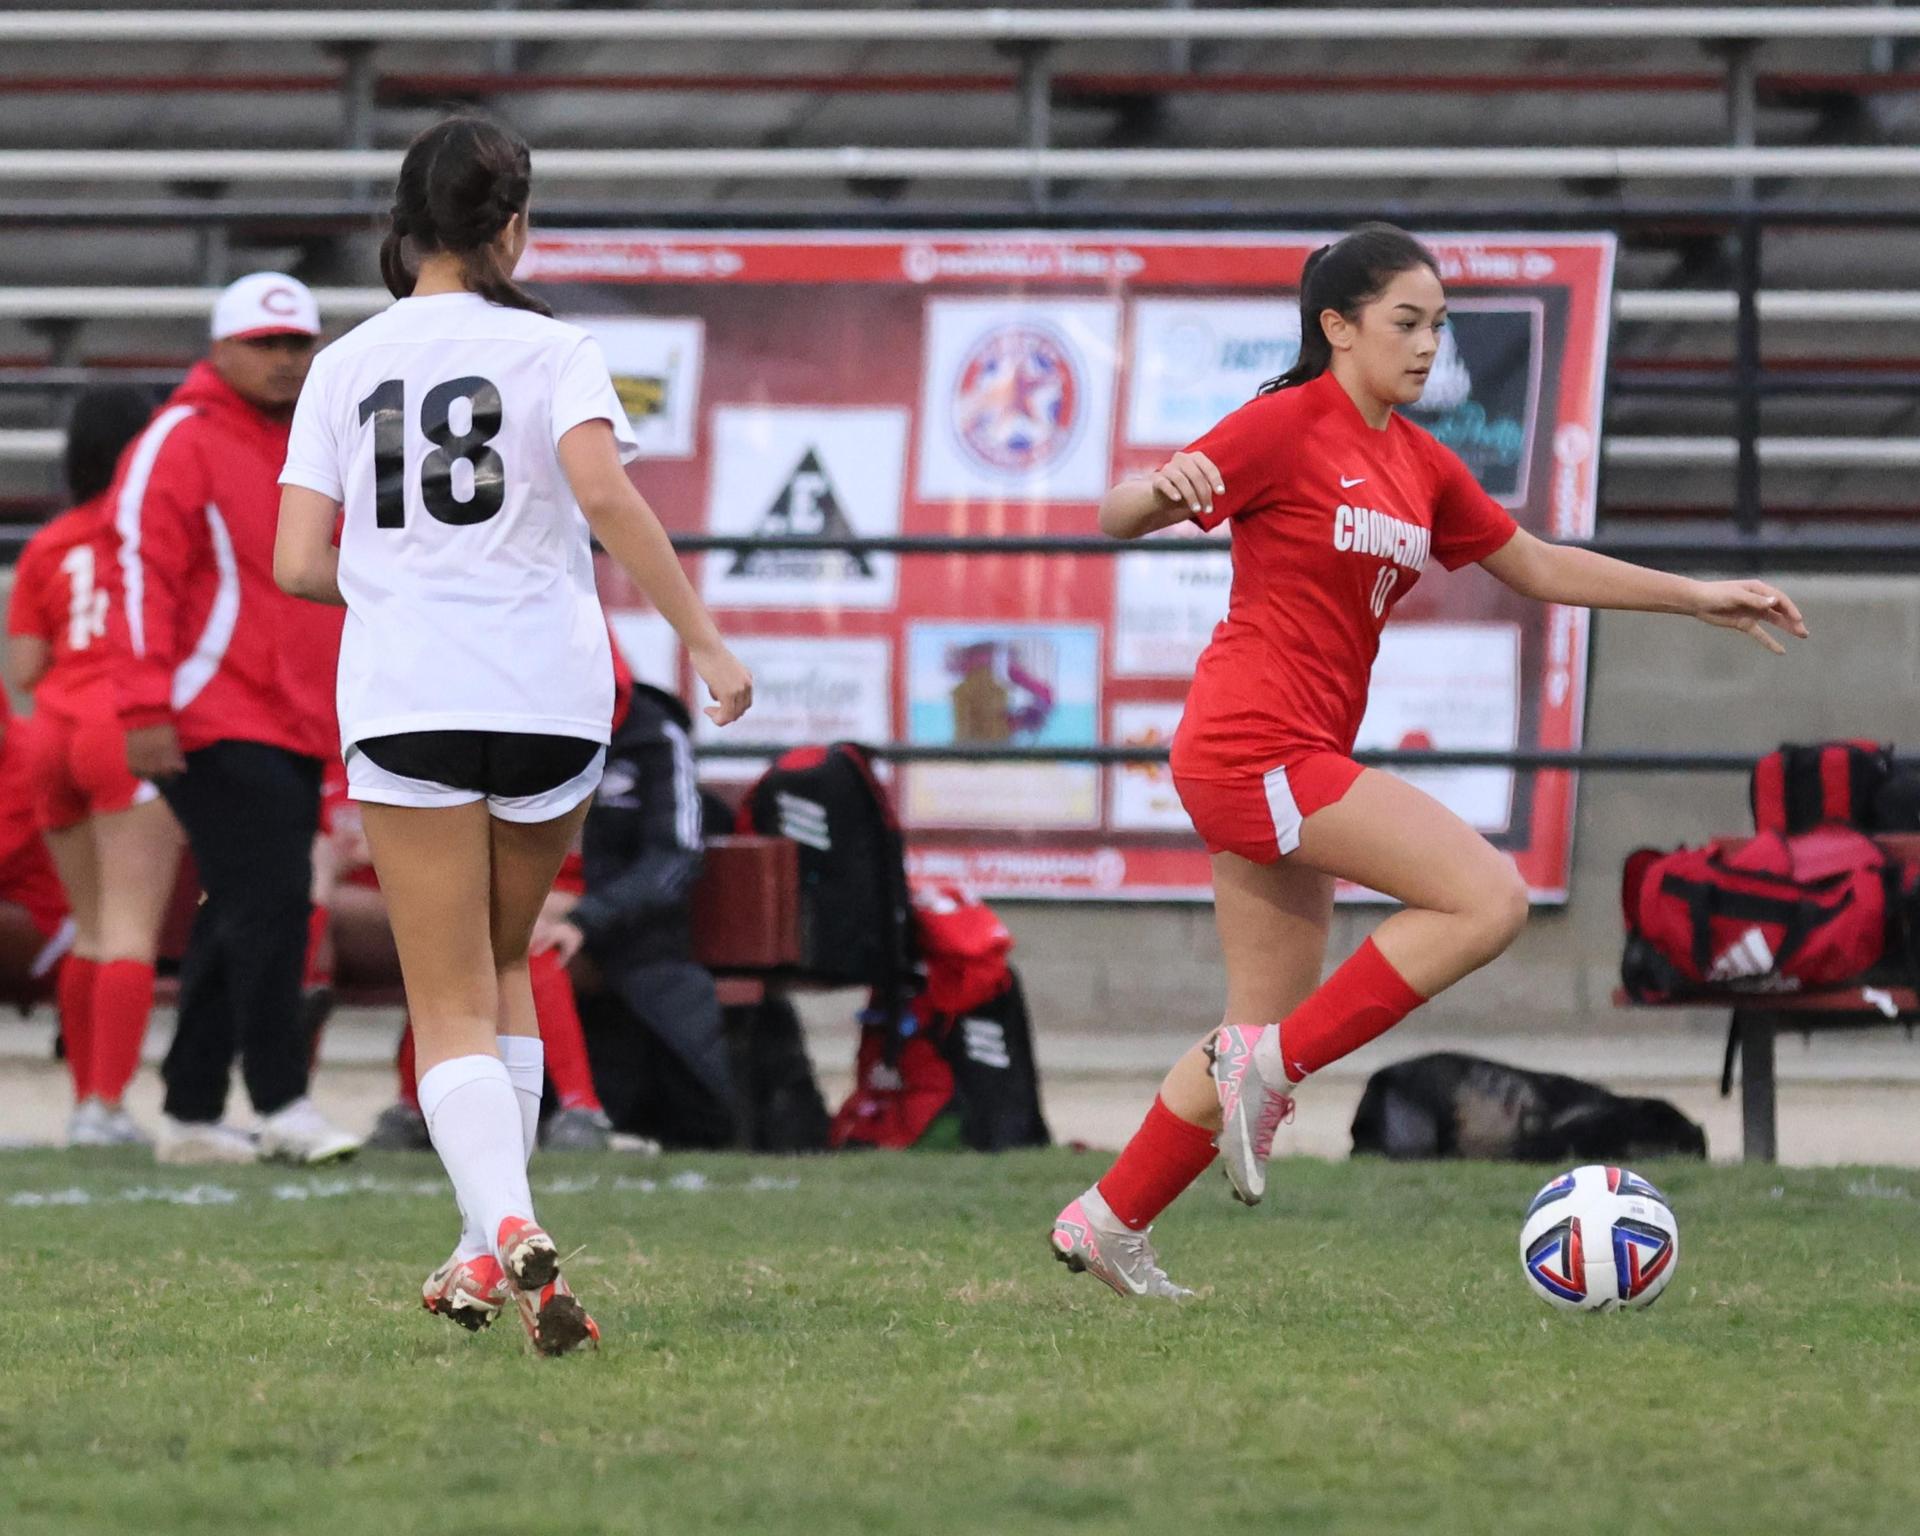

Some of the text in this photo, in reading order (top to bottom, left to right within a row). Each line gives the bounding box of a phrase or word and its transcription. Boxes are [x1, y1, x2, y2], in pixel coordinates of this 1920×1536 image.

[260, 287, 297, 317] C
[358, 375, 505, 528] 18
[1369, 564, 1399, 619] 10
